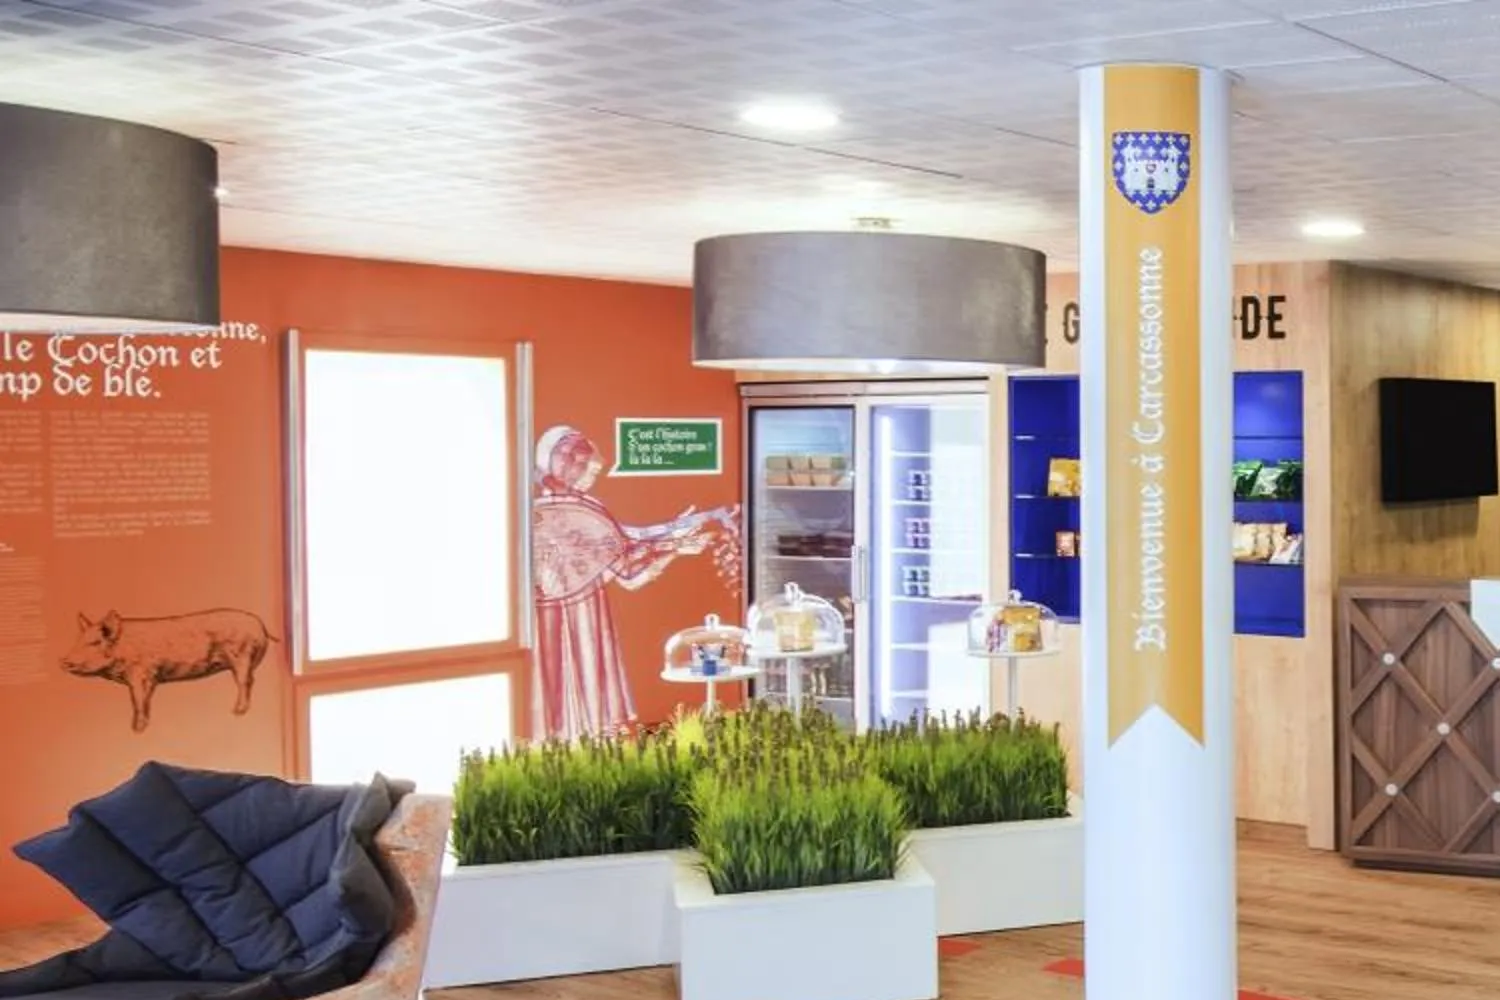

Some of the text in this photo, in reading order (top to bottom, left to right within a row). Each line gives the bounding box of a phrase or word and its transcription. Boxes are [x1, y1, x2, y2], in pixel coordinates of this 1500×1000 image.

[48, 333, 180, 370] Cochon
[190, 340, 223, 368] et
[1133, 246, 1166, 445] Carcassonne
[1133, 482, 1166, 652] Bienvenue
